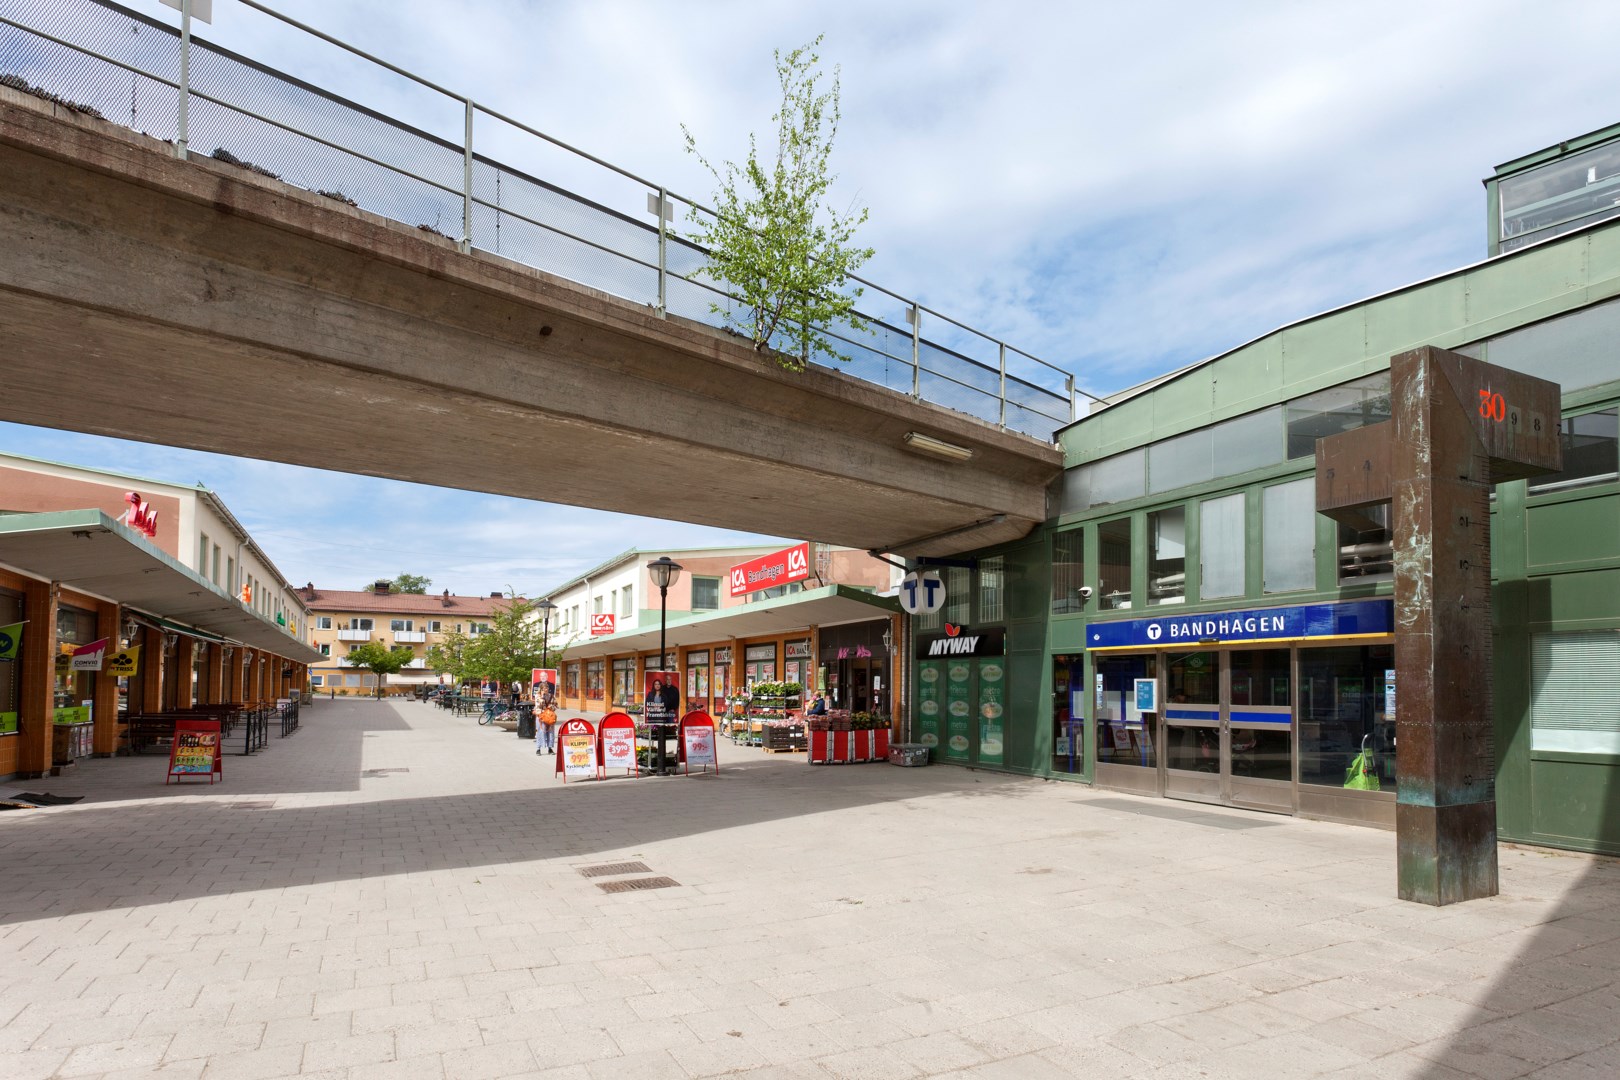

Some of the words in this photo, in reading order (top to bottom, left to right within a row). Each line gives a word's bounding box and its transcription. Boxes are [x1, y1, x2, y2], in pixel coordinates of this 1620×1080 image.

[1479, 389, 1506, 422] 30
[1511, 412, 1518, 425] 9
[1533, 418, 1541, 431] 8
[1459, 516, 1469, 527] 2
[788, 549, 807, 571] ICA
[1459, 559, 1469, 570] 3
[732, 568, 746, 587] ICA
[748, 564, 784, 583] Bandhagen
[592, 615, 613, 627] ICA
[1170, 616, 1285, 637] BANDHAGEN
[928, 636, 979, 656] MYWAY
[567, 722, 587, 731] ICA
[1463, 775, 1472, 786] 8
